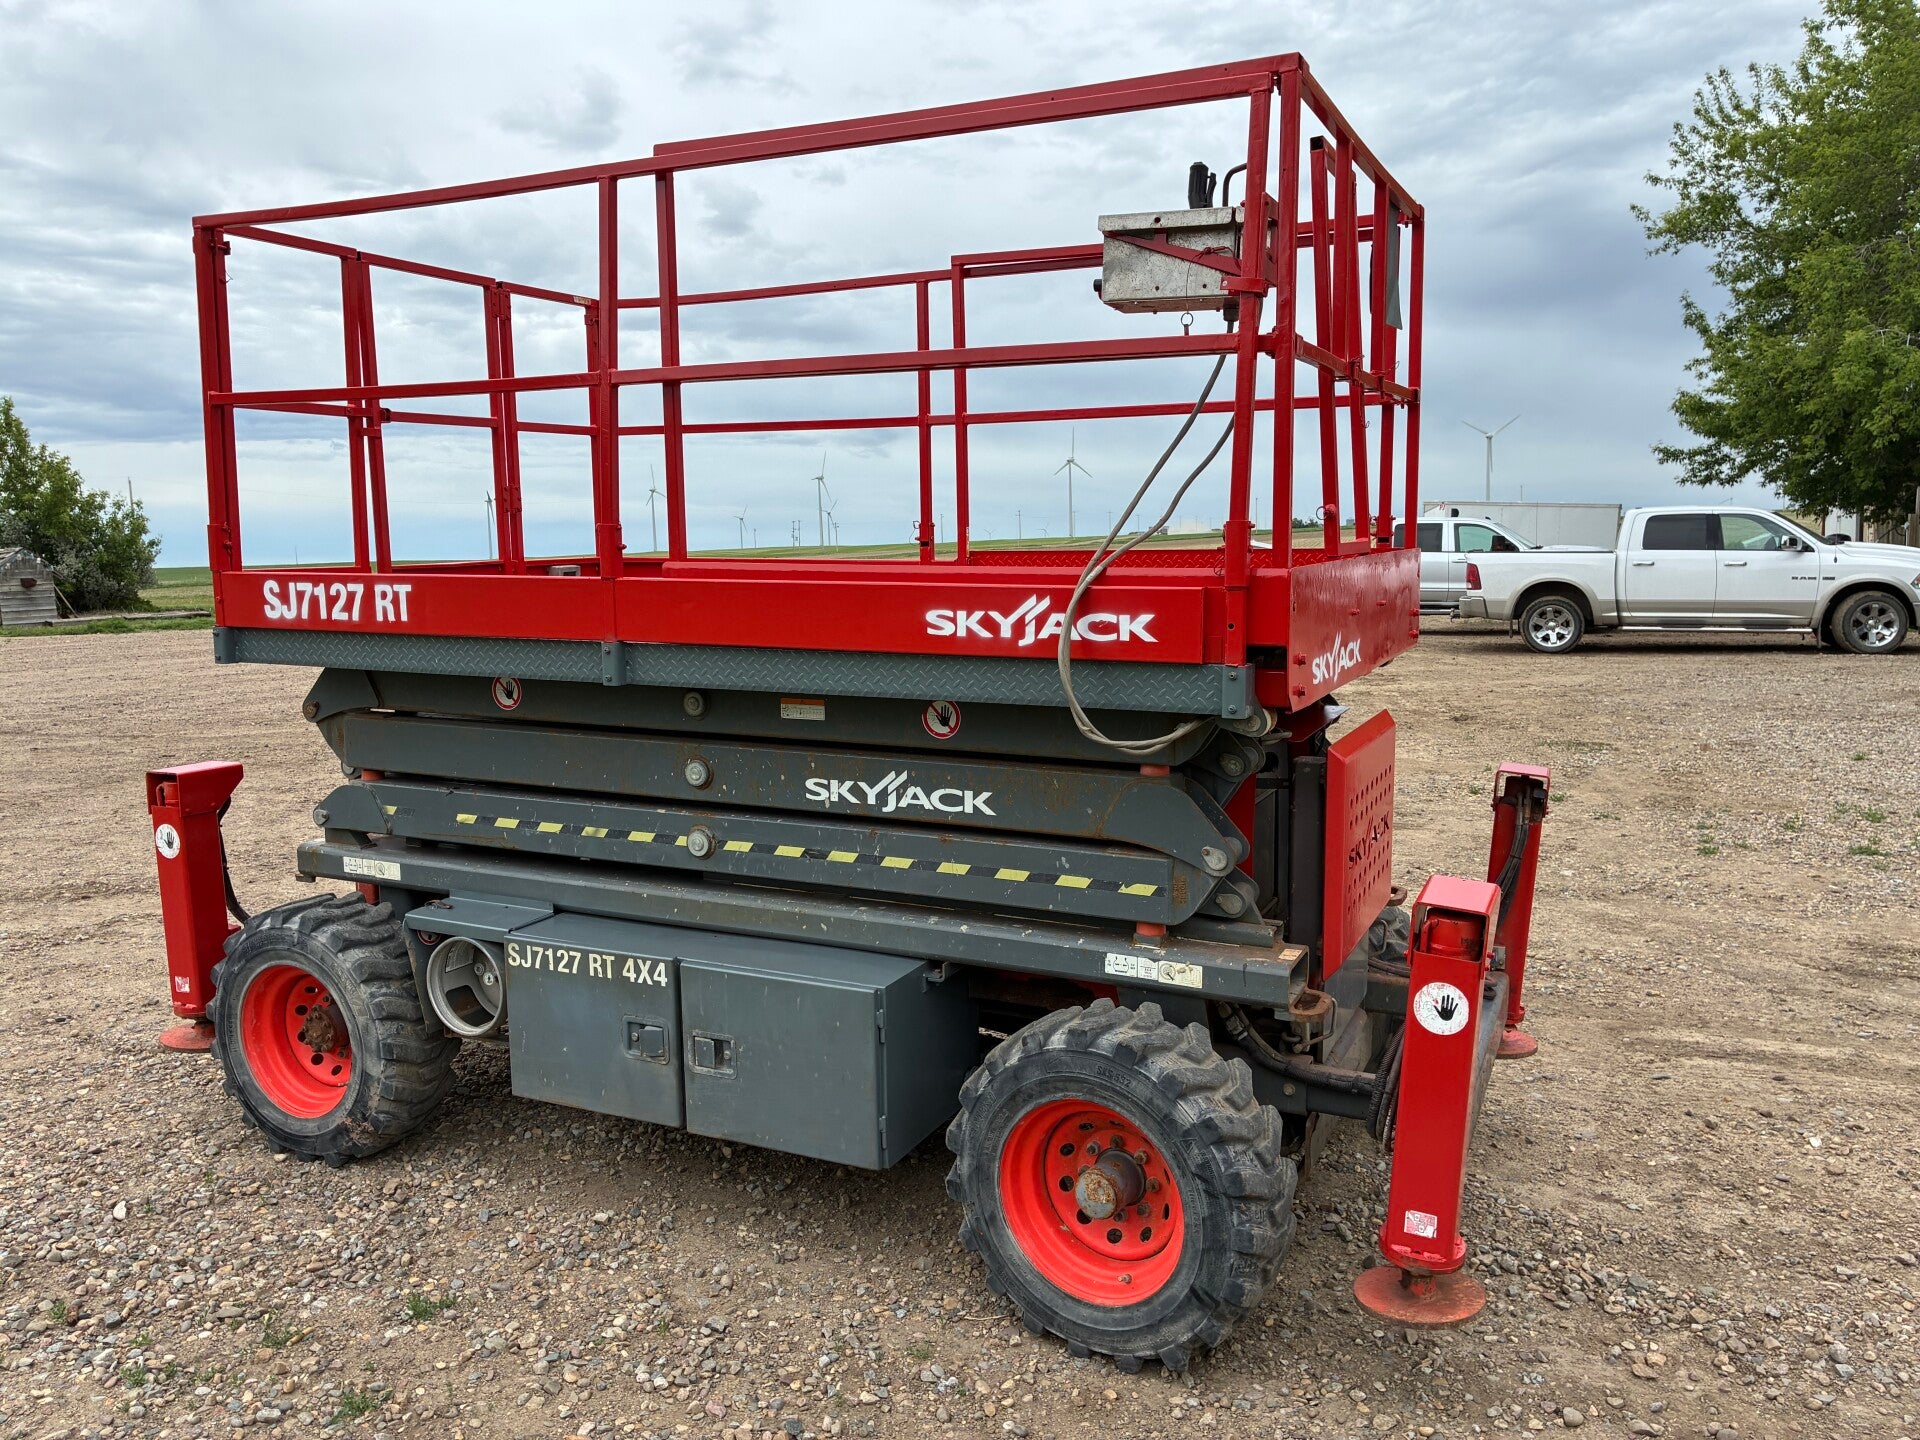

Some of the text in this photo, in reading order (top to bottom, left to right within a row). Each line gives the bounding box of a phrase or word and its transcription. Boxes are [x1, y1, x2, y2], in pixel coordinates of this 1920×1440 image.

[263, 579, 412, 622] SJ7127 RT
[925, 593, 1159, 647] SKYJACK
[1312, 630, 1362, 685] SKYJACK
[805, 769, 997, 816] SKYJACK
[1348, 810, 1390, 871] SKYJACK
[507, 942, 668, 988] SJ7127 RT 4X4
